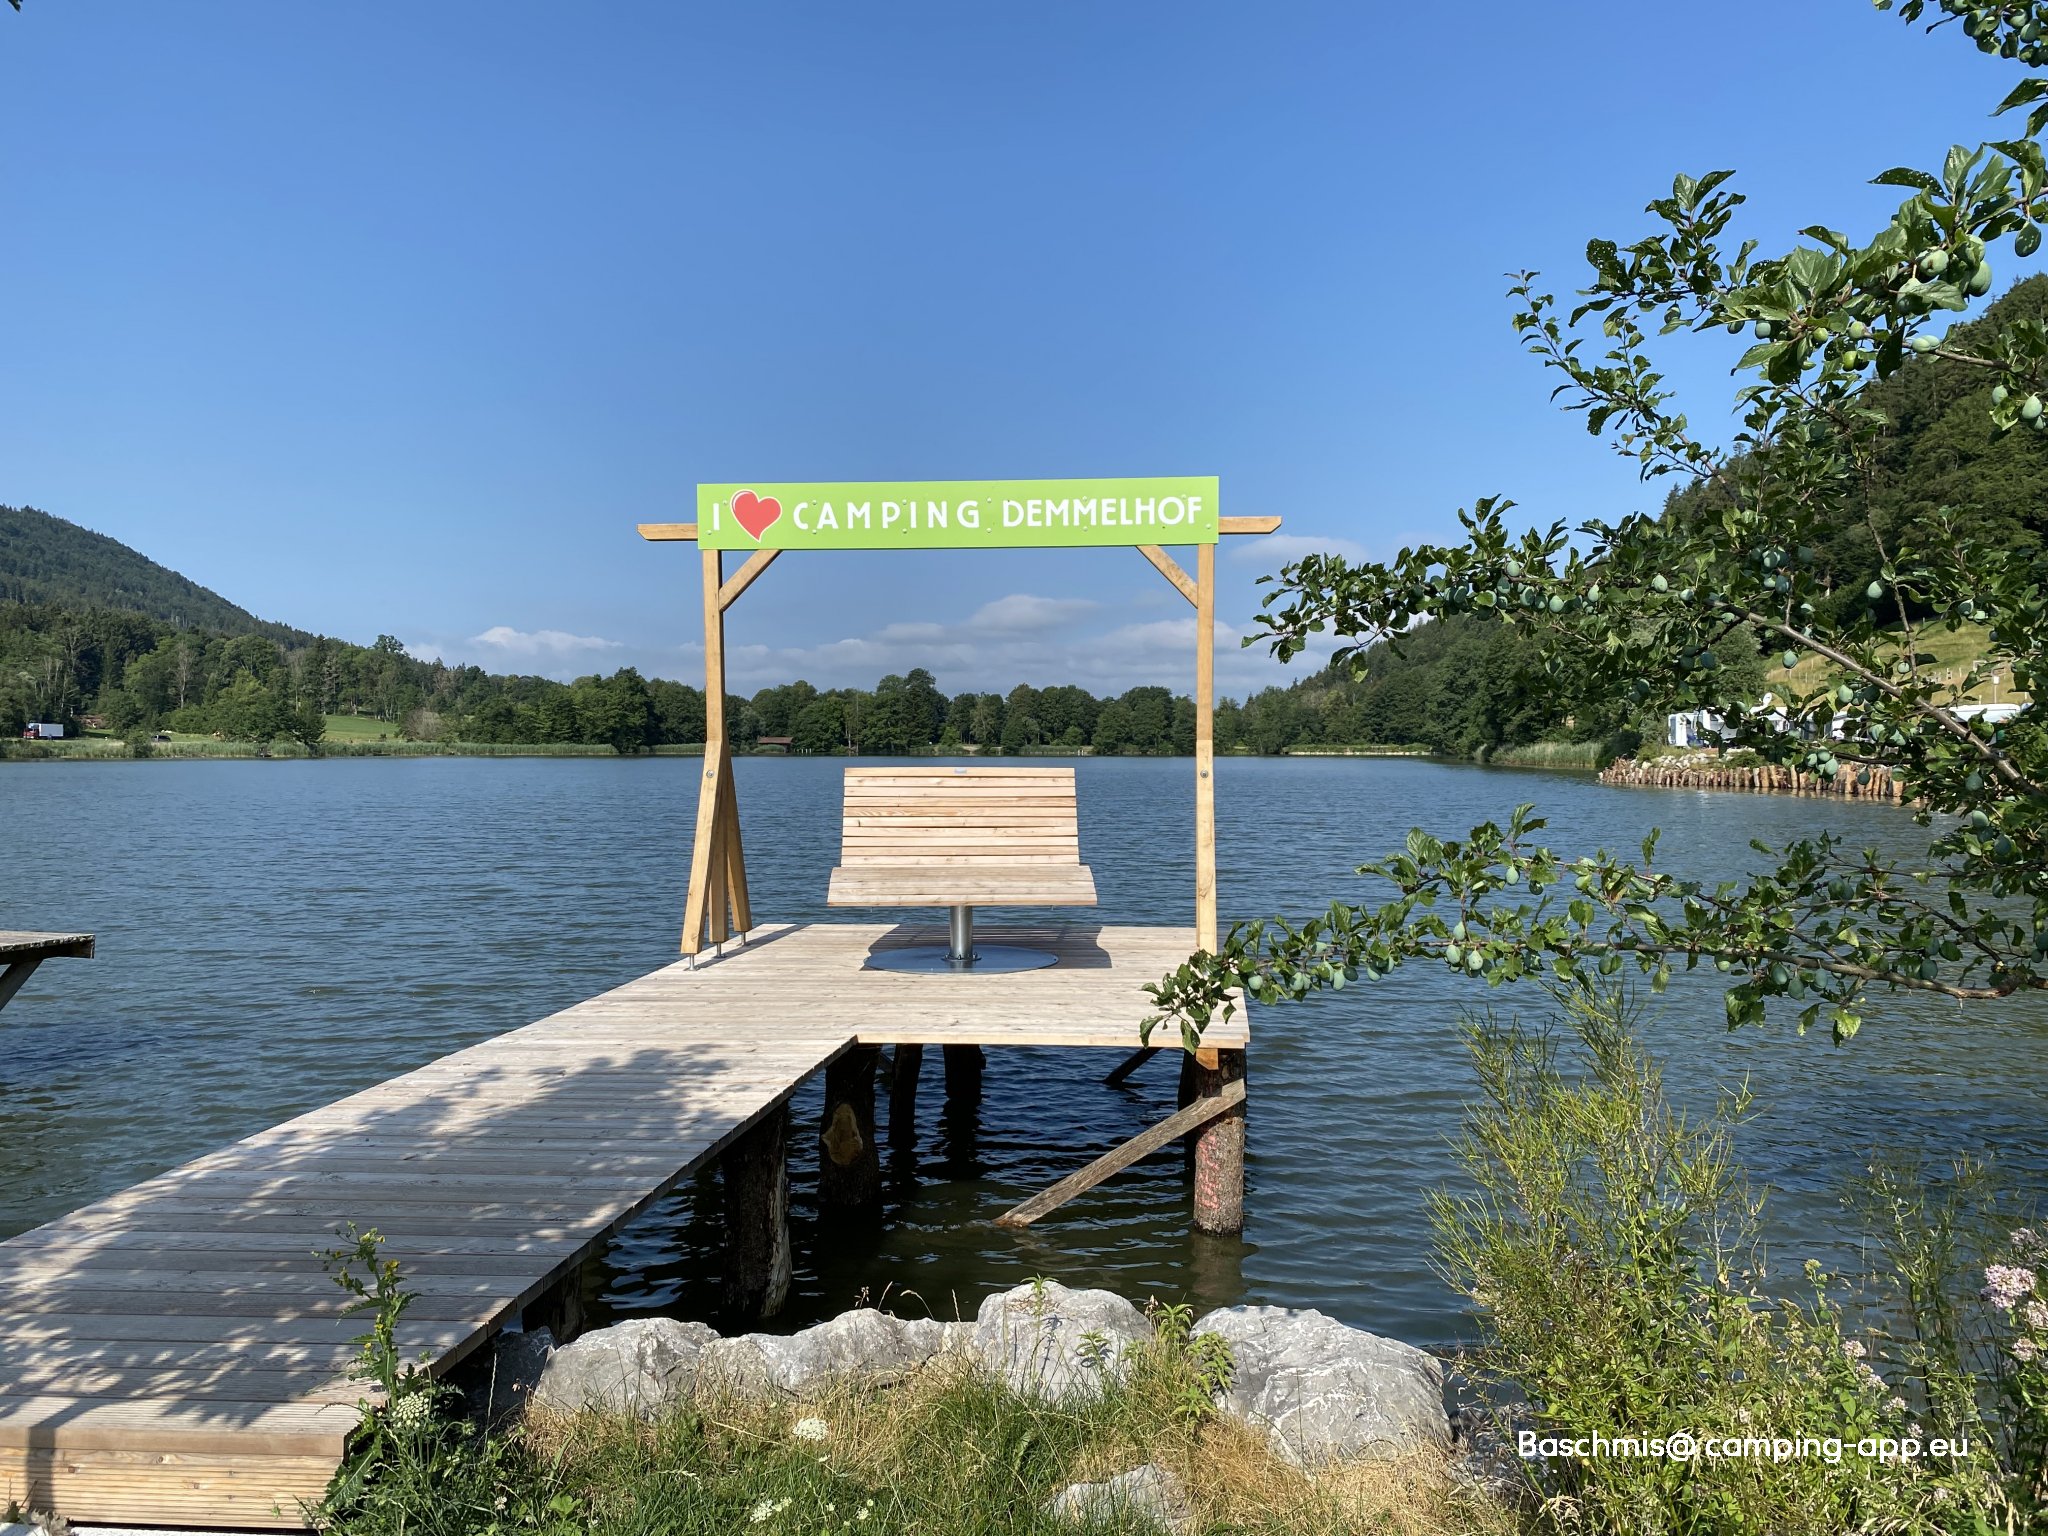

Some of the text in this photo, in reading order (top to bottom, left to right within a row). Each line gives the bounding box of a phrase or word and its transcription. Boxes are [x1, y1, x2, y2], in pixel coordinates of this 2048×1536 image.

[712, 496, 1202, 530] I CAMPING DEMMELHOF
